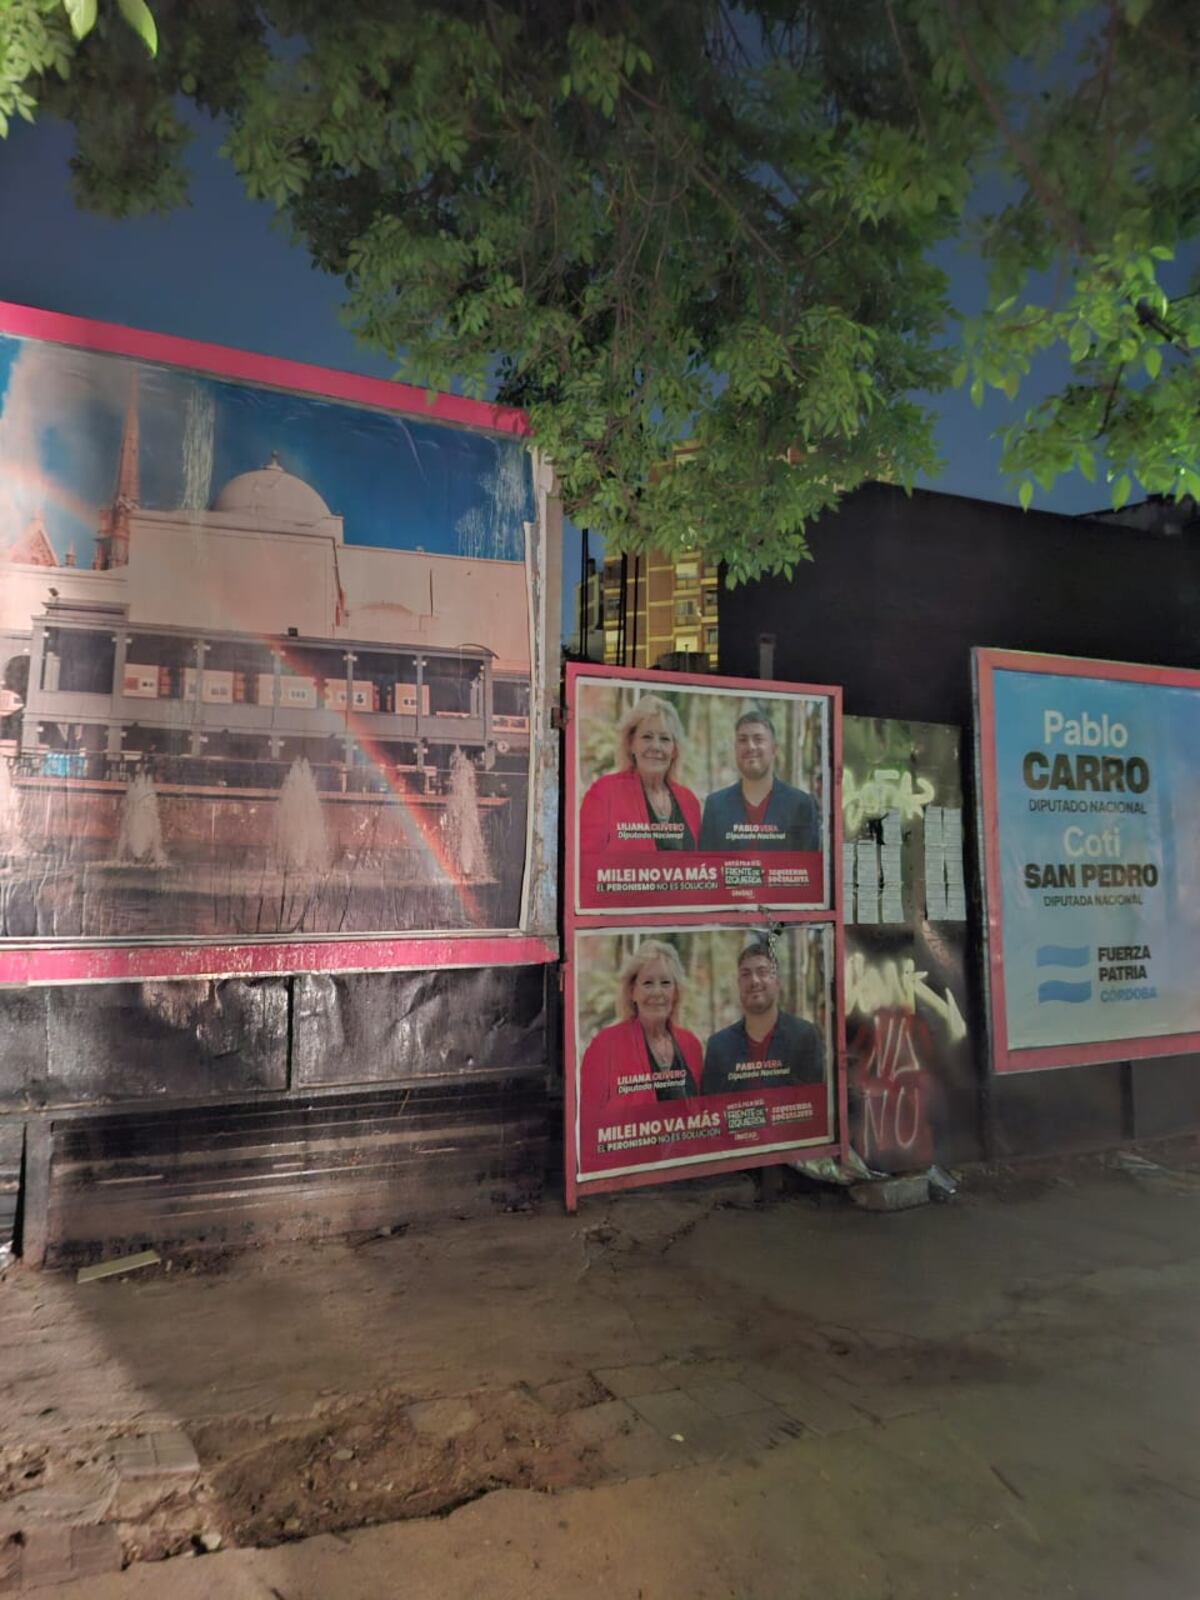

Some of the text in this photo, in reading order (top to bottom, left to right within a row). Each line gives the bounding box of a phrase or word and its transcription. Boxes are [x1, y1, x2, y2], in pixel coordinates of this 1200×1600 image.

[1043, 709, 1128, 748] Pablo
[1023, 752, 1149, 794] CARRO
[1029, 798, 1148, 815] DIPUTADO NACIONAL
[616, 822, 650, 832] LILIANA
[733, 824, 760, 832] PABLO
[1064, 825, 1121, 857] Coti
[597, 869, 636, 882] MILEI
[638, 868, 661, 881] NO
[662, 867, 684, 881] VA
[685, 863, 718, 880] MÁS
[1024, 863, 1159, 889] SAN PEDRO
[606, 883, 656, 892] PERONISMO
[1043, 892, 1144, 908] DIPUTADA NACIONAL
[1098, 945, 1151, 962] FUERZA
[1099, 965, 1148, 982] PATRIA
[735, 1061, 762, 1072] PABLO
[617, 1073, 651, 1085] LILIANA
[598, 1109, 721, 1142] MILEI NO VA MÁS
[607, 1137, 657, 1152] PERONISMO
